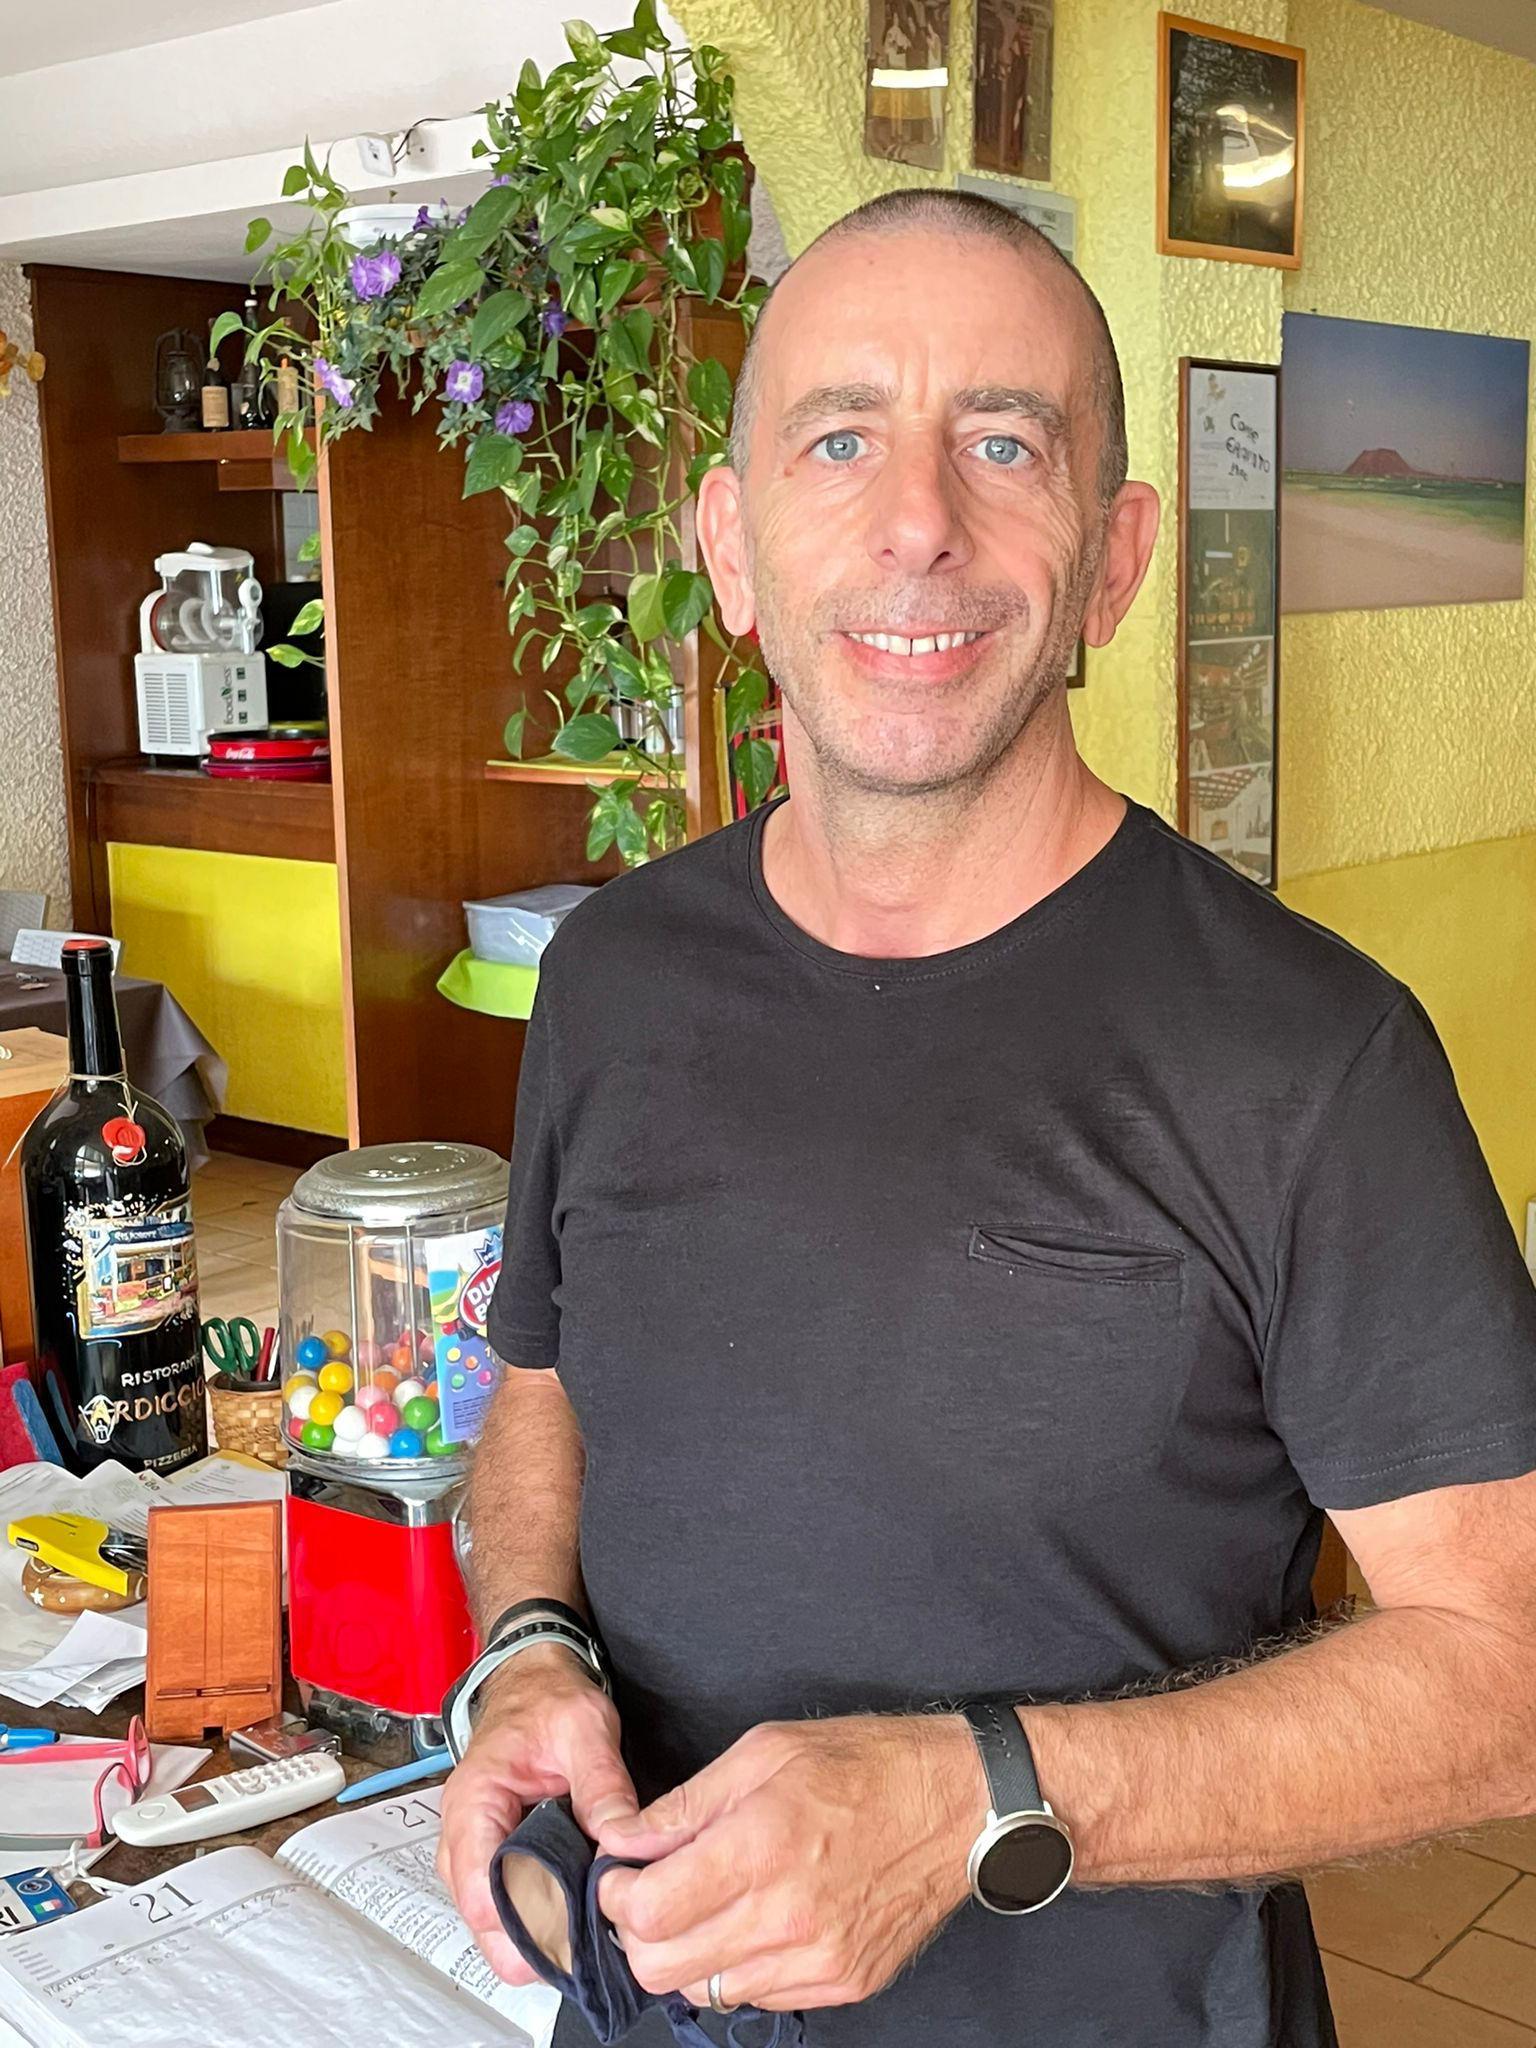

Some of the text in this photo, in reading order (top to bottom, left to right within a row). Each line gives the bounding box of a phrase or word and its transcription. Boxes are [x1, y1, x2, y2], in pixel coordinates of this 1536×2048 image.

[143, 1445, 198, 1469] PIZZERIA
[383, 1799, 442, 1828] 21
[129, 1881, 202, 1924] 21
